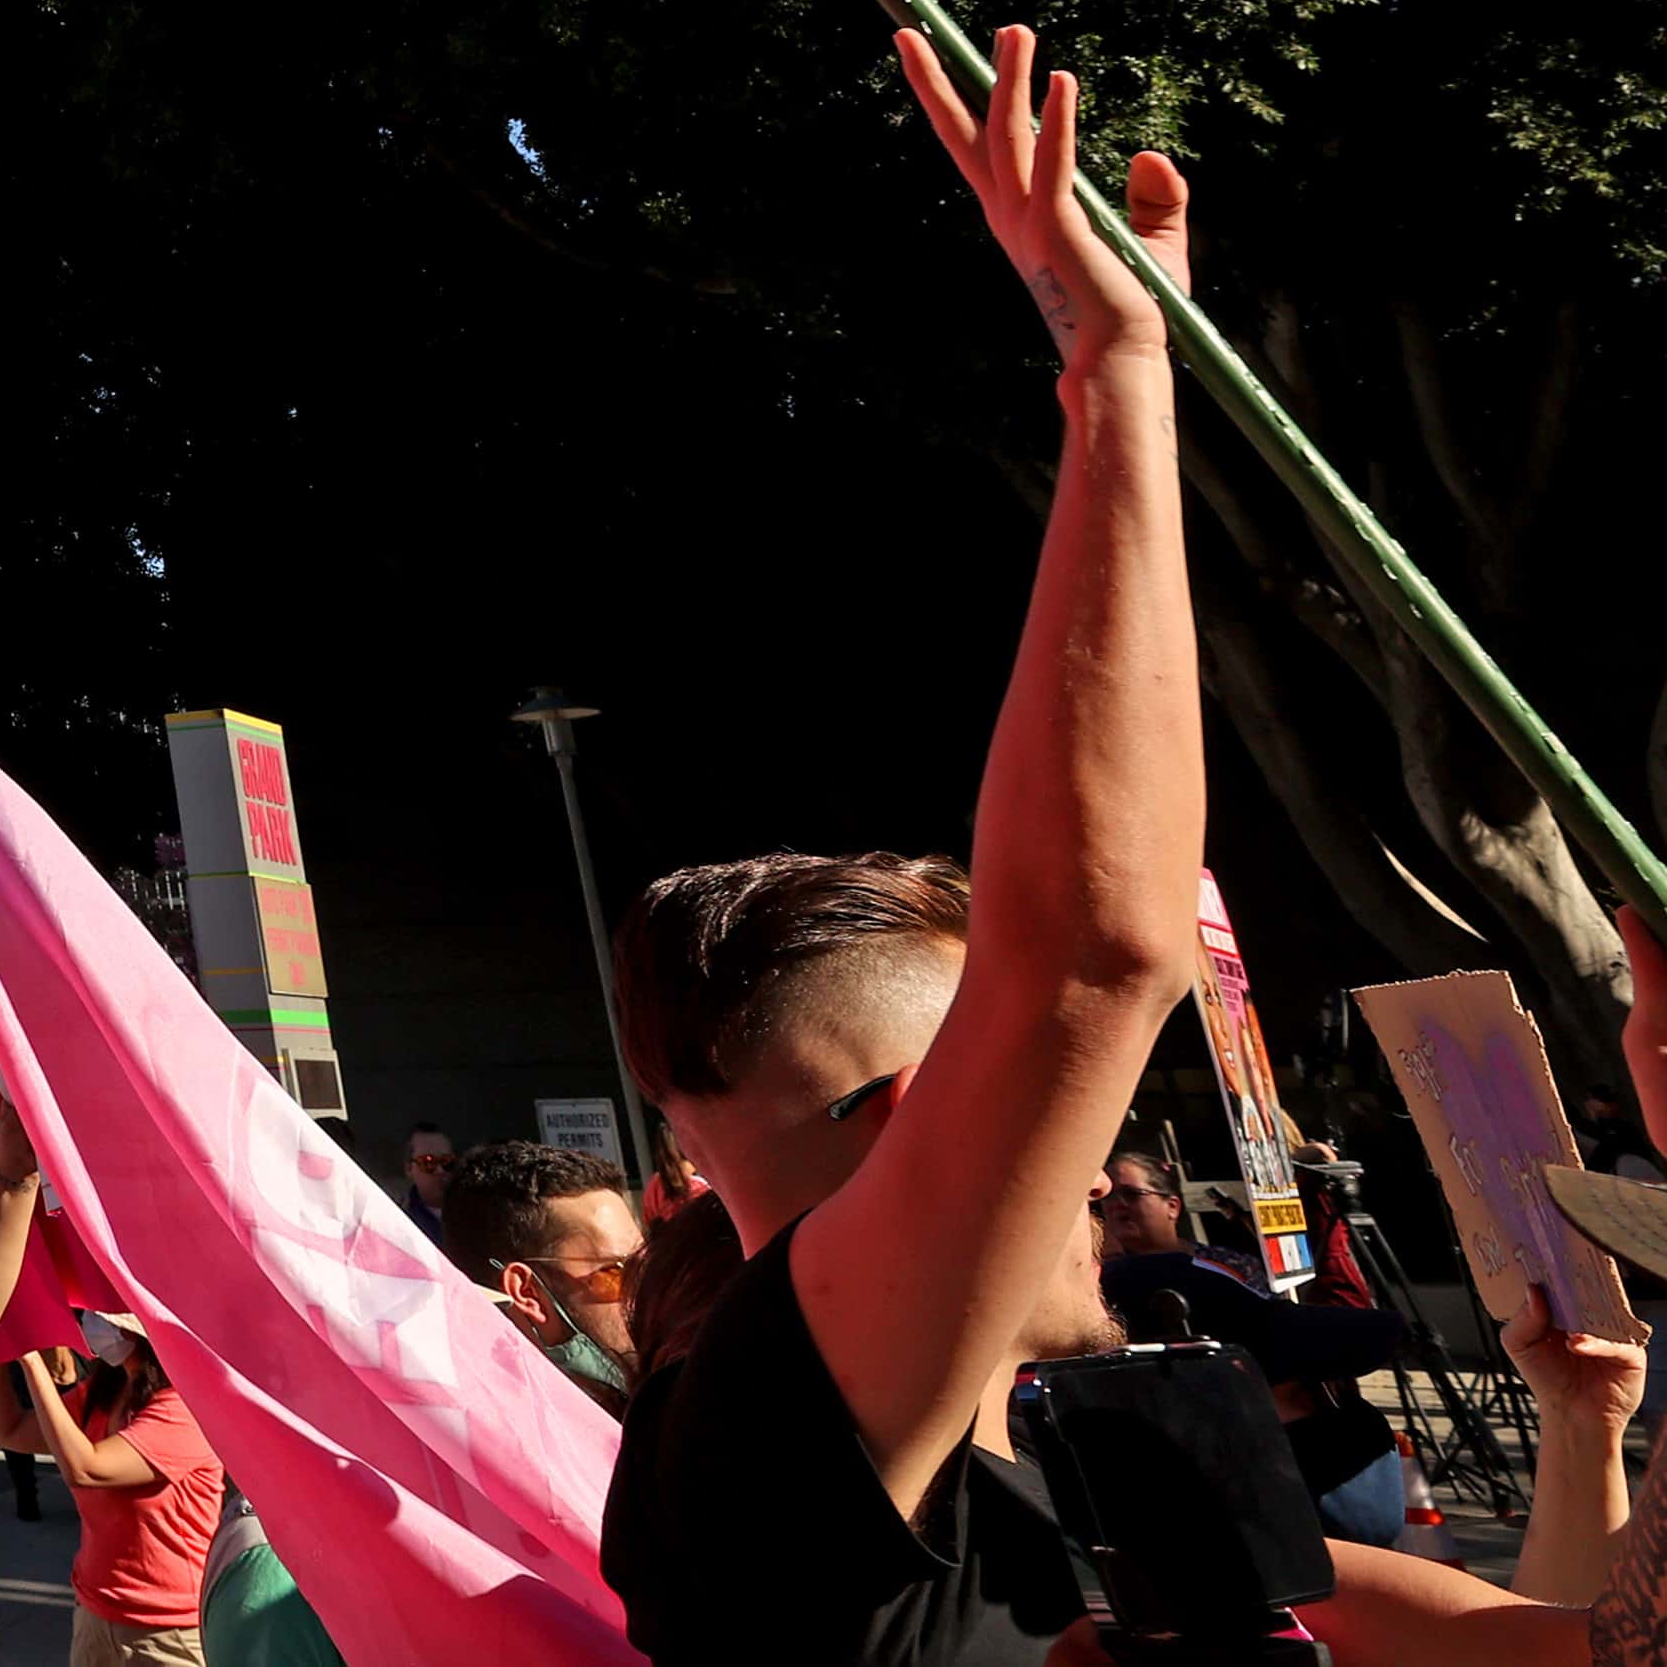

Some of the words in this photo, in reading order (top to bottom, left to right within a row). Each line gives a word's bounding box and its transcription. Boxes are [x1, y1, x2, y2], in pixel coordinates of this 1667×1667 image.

[236, 738, 286, 806] GRAND
[245, 800, 298, 867] PARK
[557, 1132, 604, 1148] PERMITS
